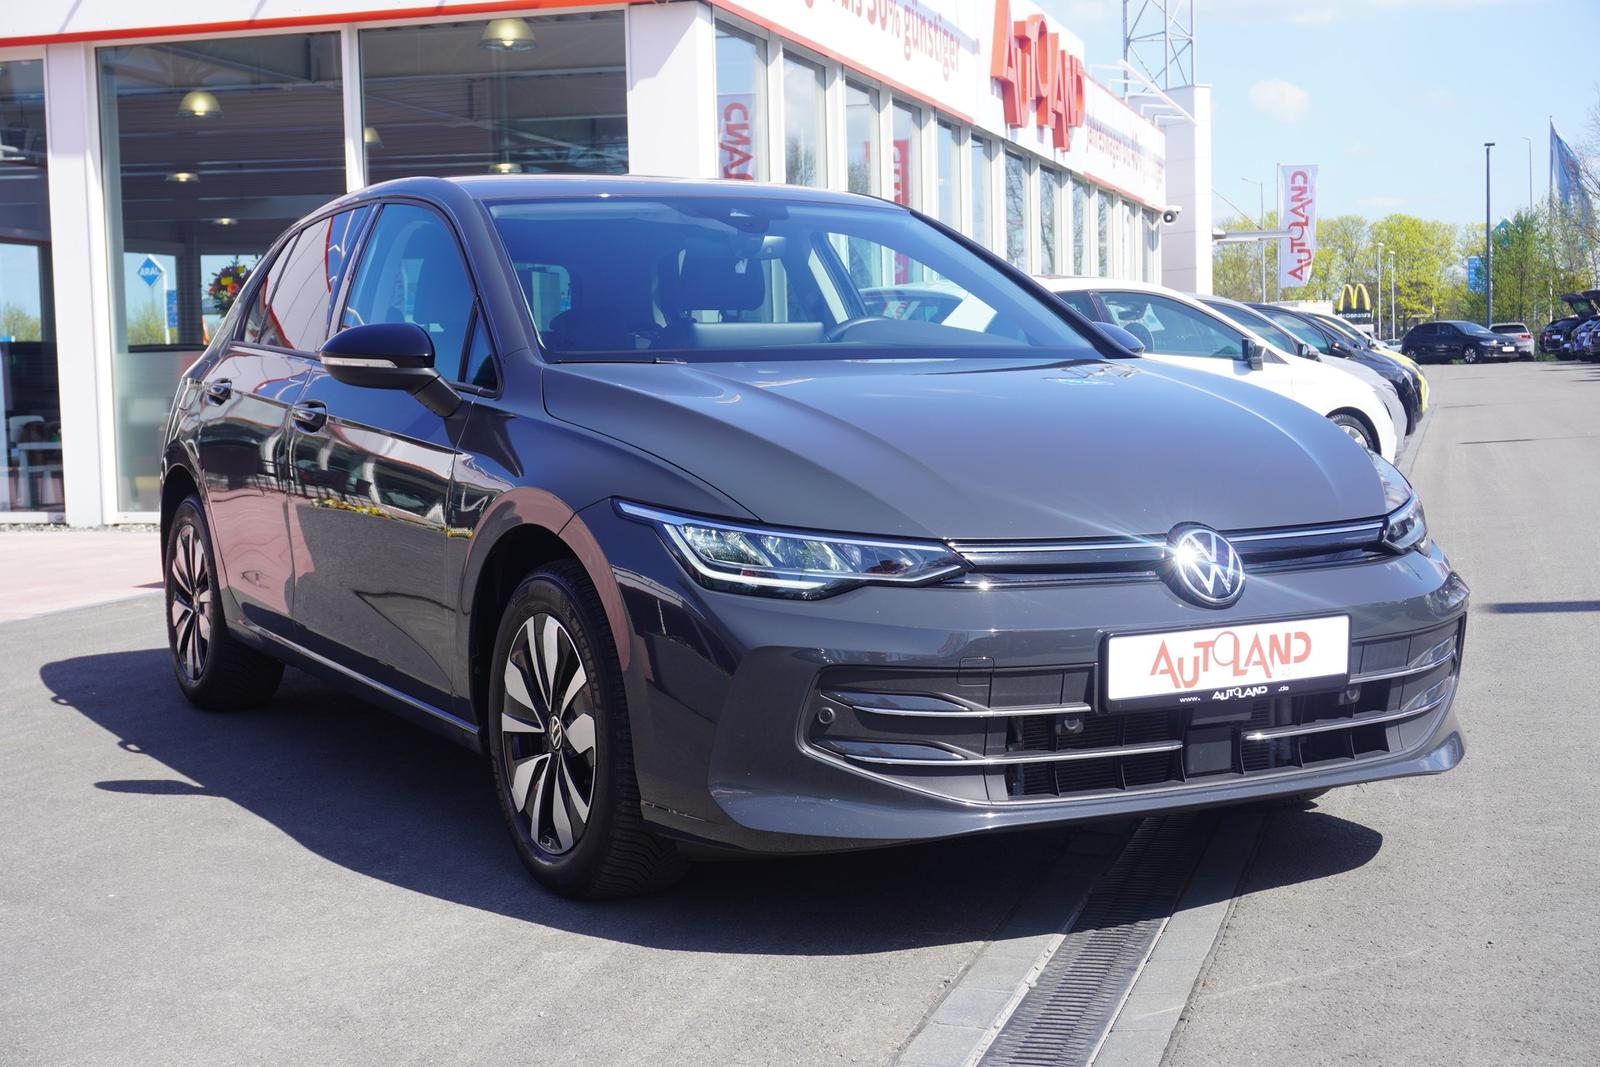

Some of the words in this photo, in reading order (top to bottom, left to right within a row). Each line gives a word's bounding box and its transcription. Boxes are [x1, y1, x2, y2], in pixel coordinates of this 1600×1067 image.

[903, 0, 961, 82] günstiger
[1287, 170, 1313, 281] AUTOLAND
[1150, 630, 1312, 689] AUTOLAND
[1211, 686, 1268, 701] AUTOLAND
